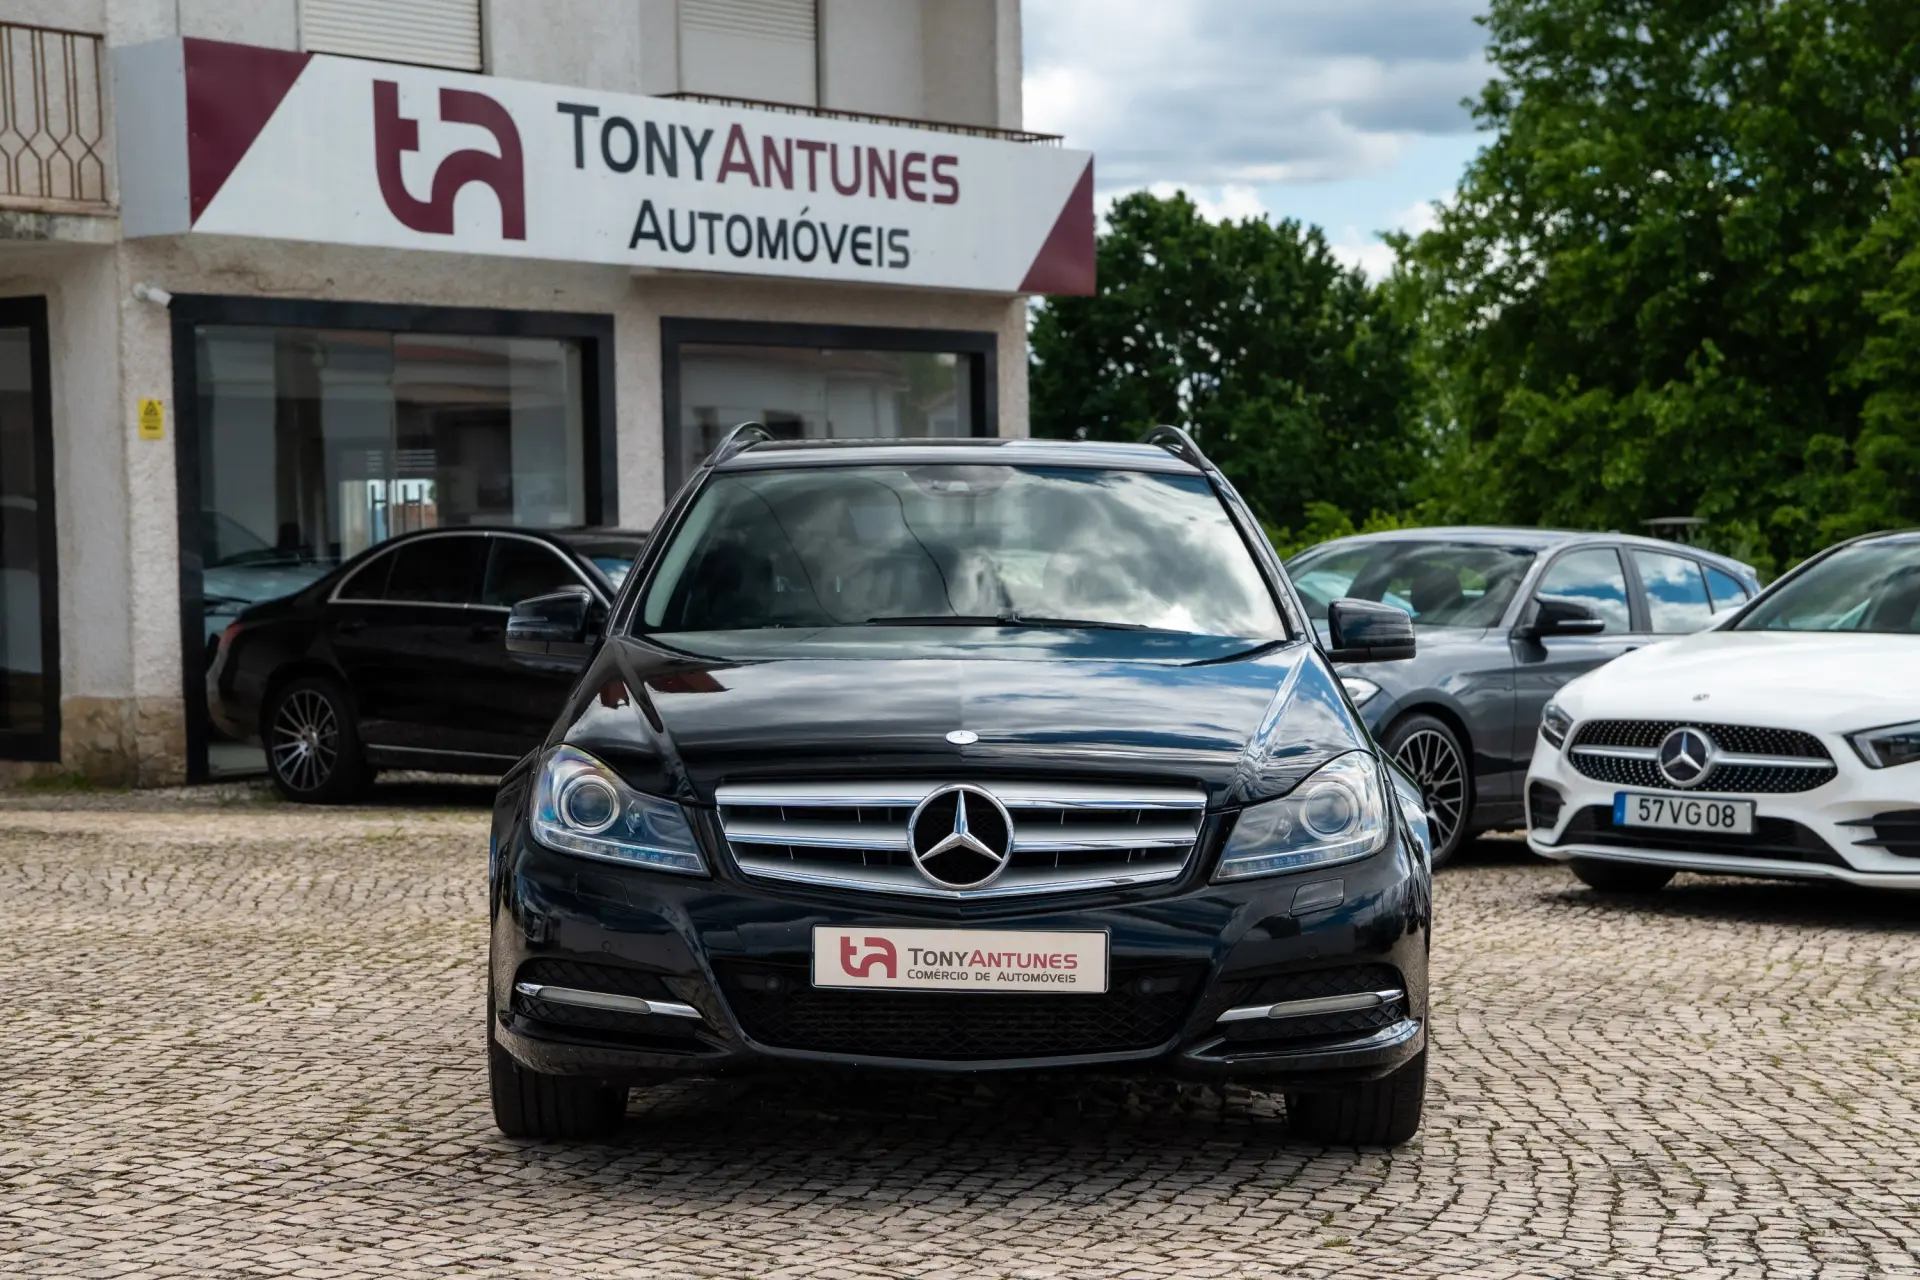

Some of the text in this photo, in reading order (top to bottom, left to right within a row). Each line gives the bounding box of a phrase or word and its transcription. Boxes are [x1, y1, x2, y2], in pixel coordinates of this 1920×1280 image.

[628, 198, 911, 270] AUTOMÓVEIS
[907, 967, 1077, 984] COMÉRCIO DE AUTOMÓVEIS
